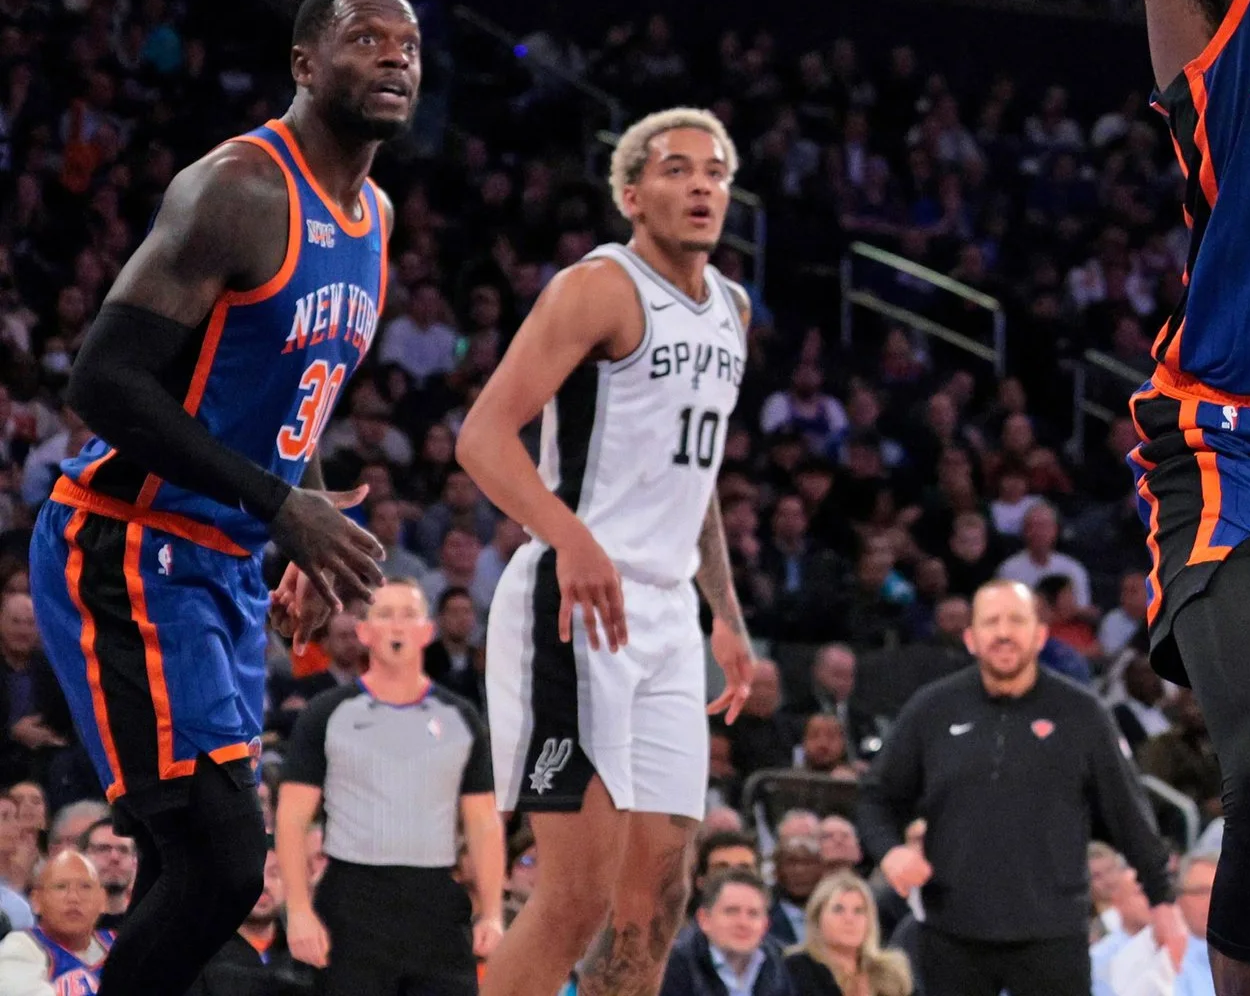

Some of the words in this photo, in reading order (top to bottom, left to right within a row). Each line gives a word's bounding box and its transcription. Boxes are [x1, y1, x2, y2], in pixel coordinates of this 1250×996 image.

[281, 282, 344, 354] NEW
[650, 341, 747, 390] SPURS
[672, 406, 719, 469] 10
